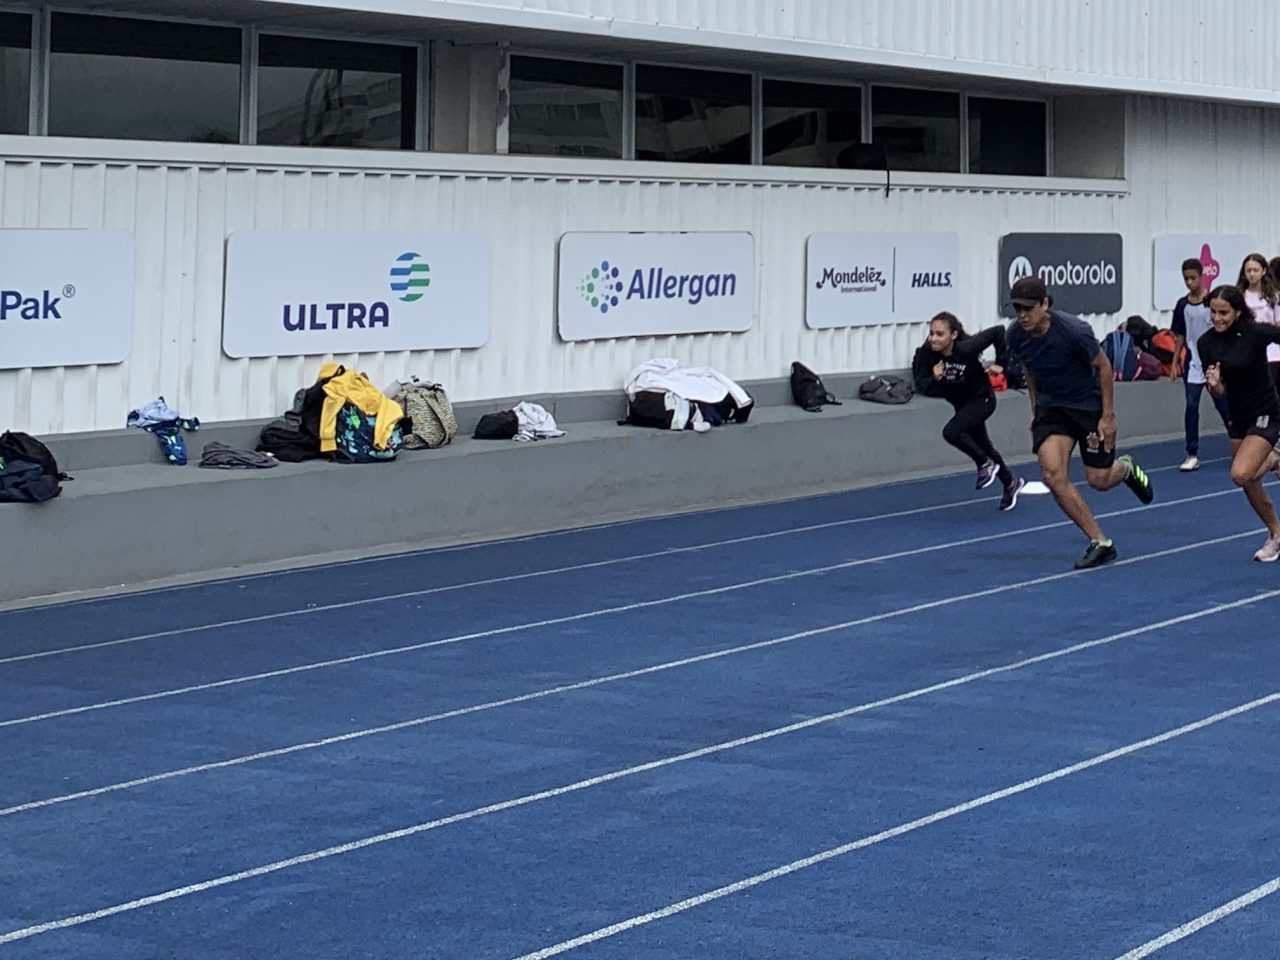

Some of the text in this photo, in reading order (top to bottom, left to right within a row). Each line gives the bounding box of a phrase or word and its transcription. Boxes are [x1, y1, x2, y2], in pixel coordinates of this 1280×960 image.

[626, 267, 736, 305] Allergan
[911, 272, 953, 288] HALLS
[1038, 260, 1116, 286] motorola
[283, 301, 389, 332] ULTRA
